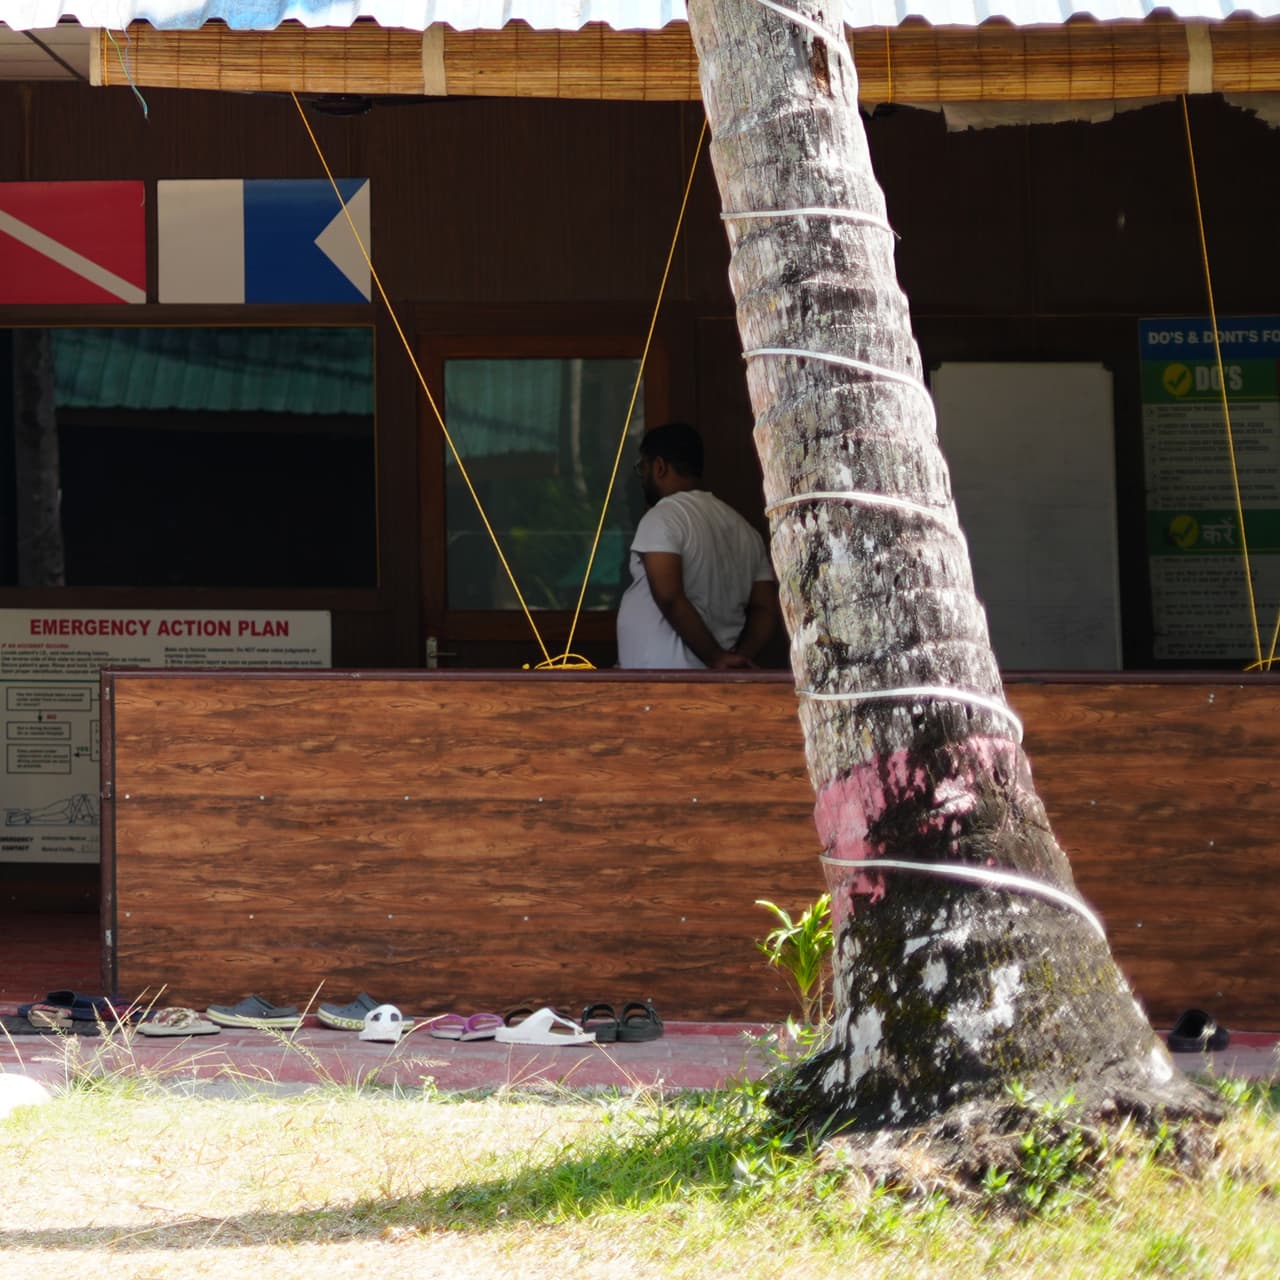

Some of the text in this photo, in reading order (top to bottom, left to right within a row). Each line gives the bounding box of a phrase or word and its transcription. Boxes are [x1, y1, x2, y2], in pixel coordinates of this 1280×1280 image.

[1148, 331, 1185, 345] DO'S
[1187, 331, 1199, 344] &
[1195, 365, 1243, 391] DO'S
[30, 619, 290, 637] EMERGENCY ACTION PLAN
